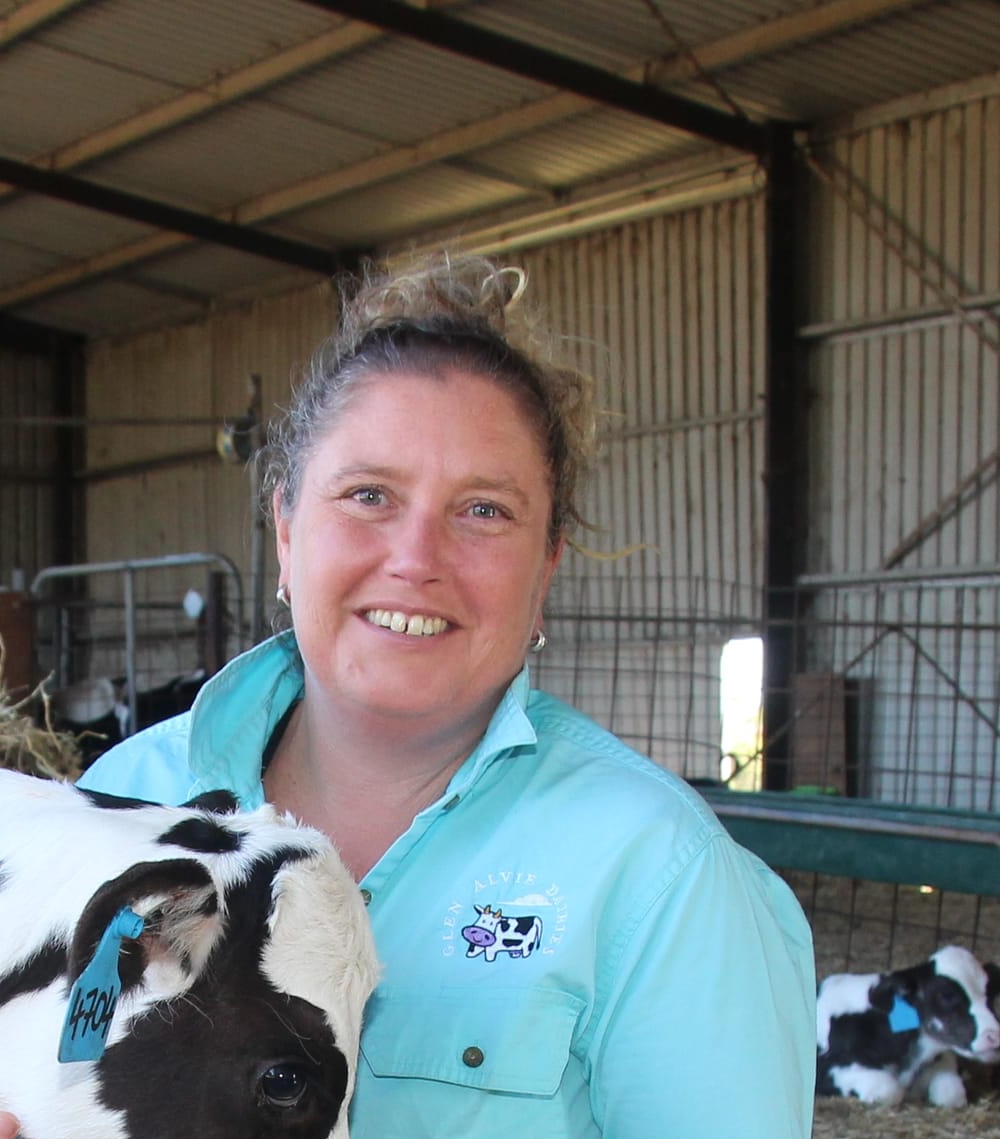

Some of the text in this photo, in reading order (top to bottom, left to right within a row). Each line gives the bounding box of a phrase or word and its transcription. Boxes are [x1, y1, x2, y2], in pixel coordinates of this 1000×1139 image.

[442, 901, 463, 957] GLEN
[474, 870, 537, 893] ALVIE
[70, 984, 116, 1040] 4704
